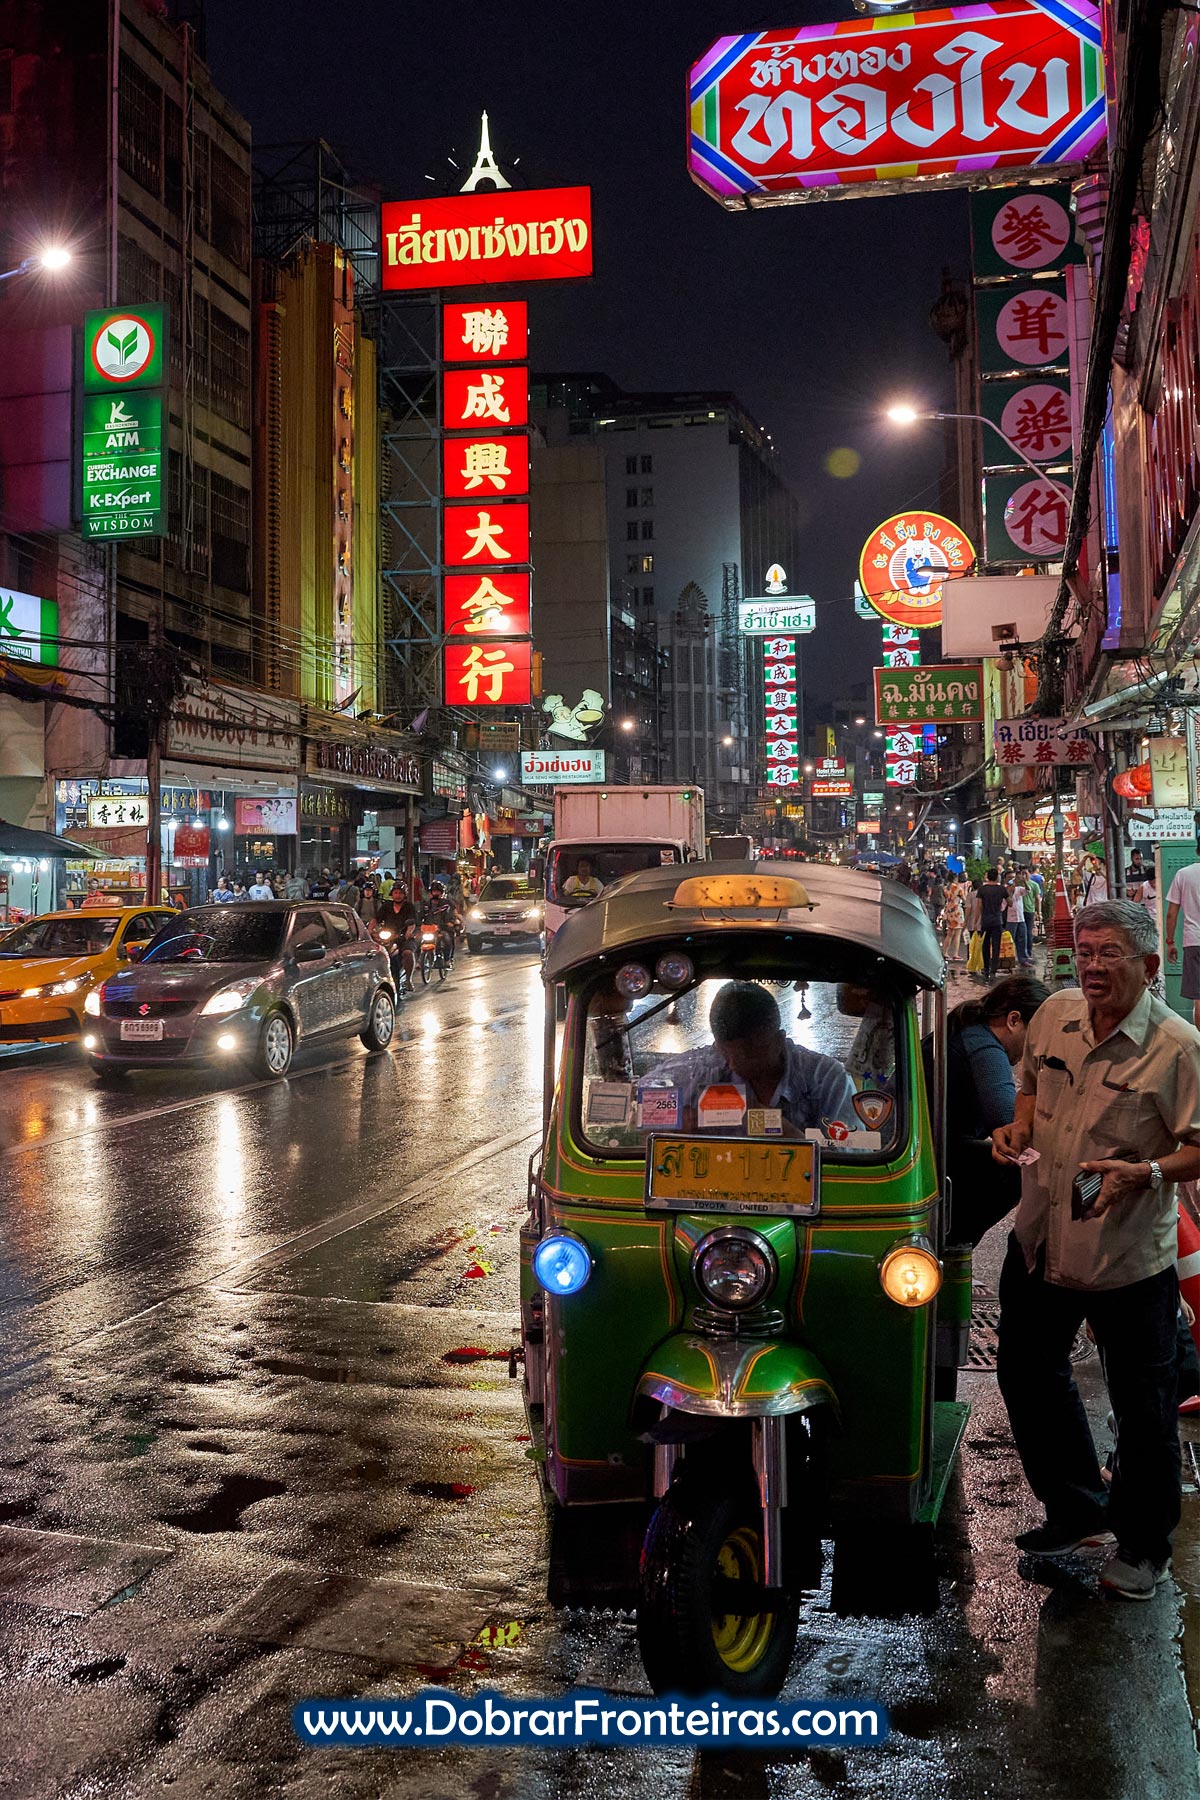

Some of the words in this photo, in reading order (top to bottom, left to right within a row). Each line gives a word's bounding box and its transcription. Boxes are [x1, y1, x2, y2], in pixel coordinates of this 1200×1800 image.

[750, 42, 912, 88] ห้างทอง
[731, 31, 1071, 164] ทองใบ
[106, 432, 140, 448] ATM
[87, 465, 157, 482] EXCHANGE
[90, 487, 151, 508] K-Expert
[459, 308, 514, 702] 聯成興大金行
[89, 518, 153, 532] WISDOM
[882, 671, 978, 703] ฉ.มั่นคง
[656, 1100, 678, 1110] 2563
[738, 1149, 798, 1182] 117
[694, 1201, 726, 1210] TOYOTA
[740, 1204, 769, 1212] UNITED
